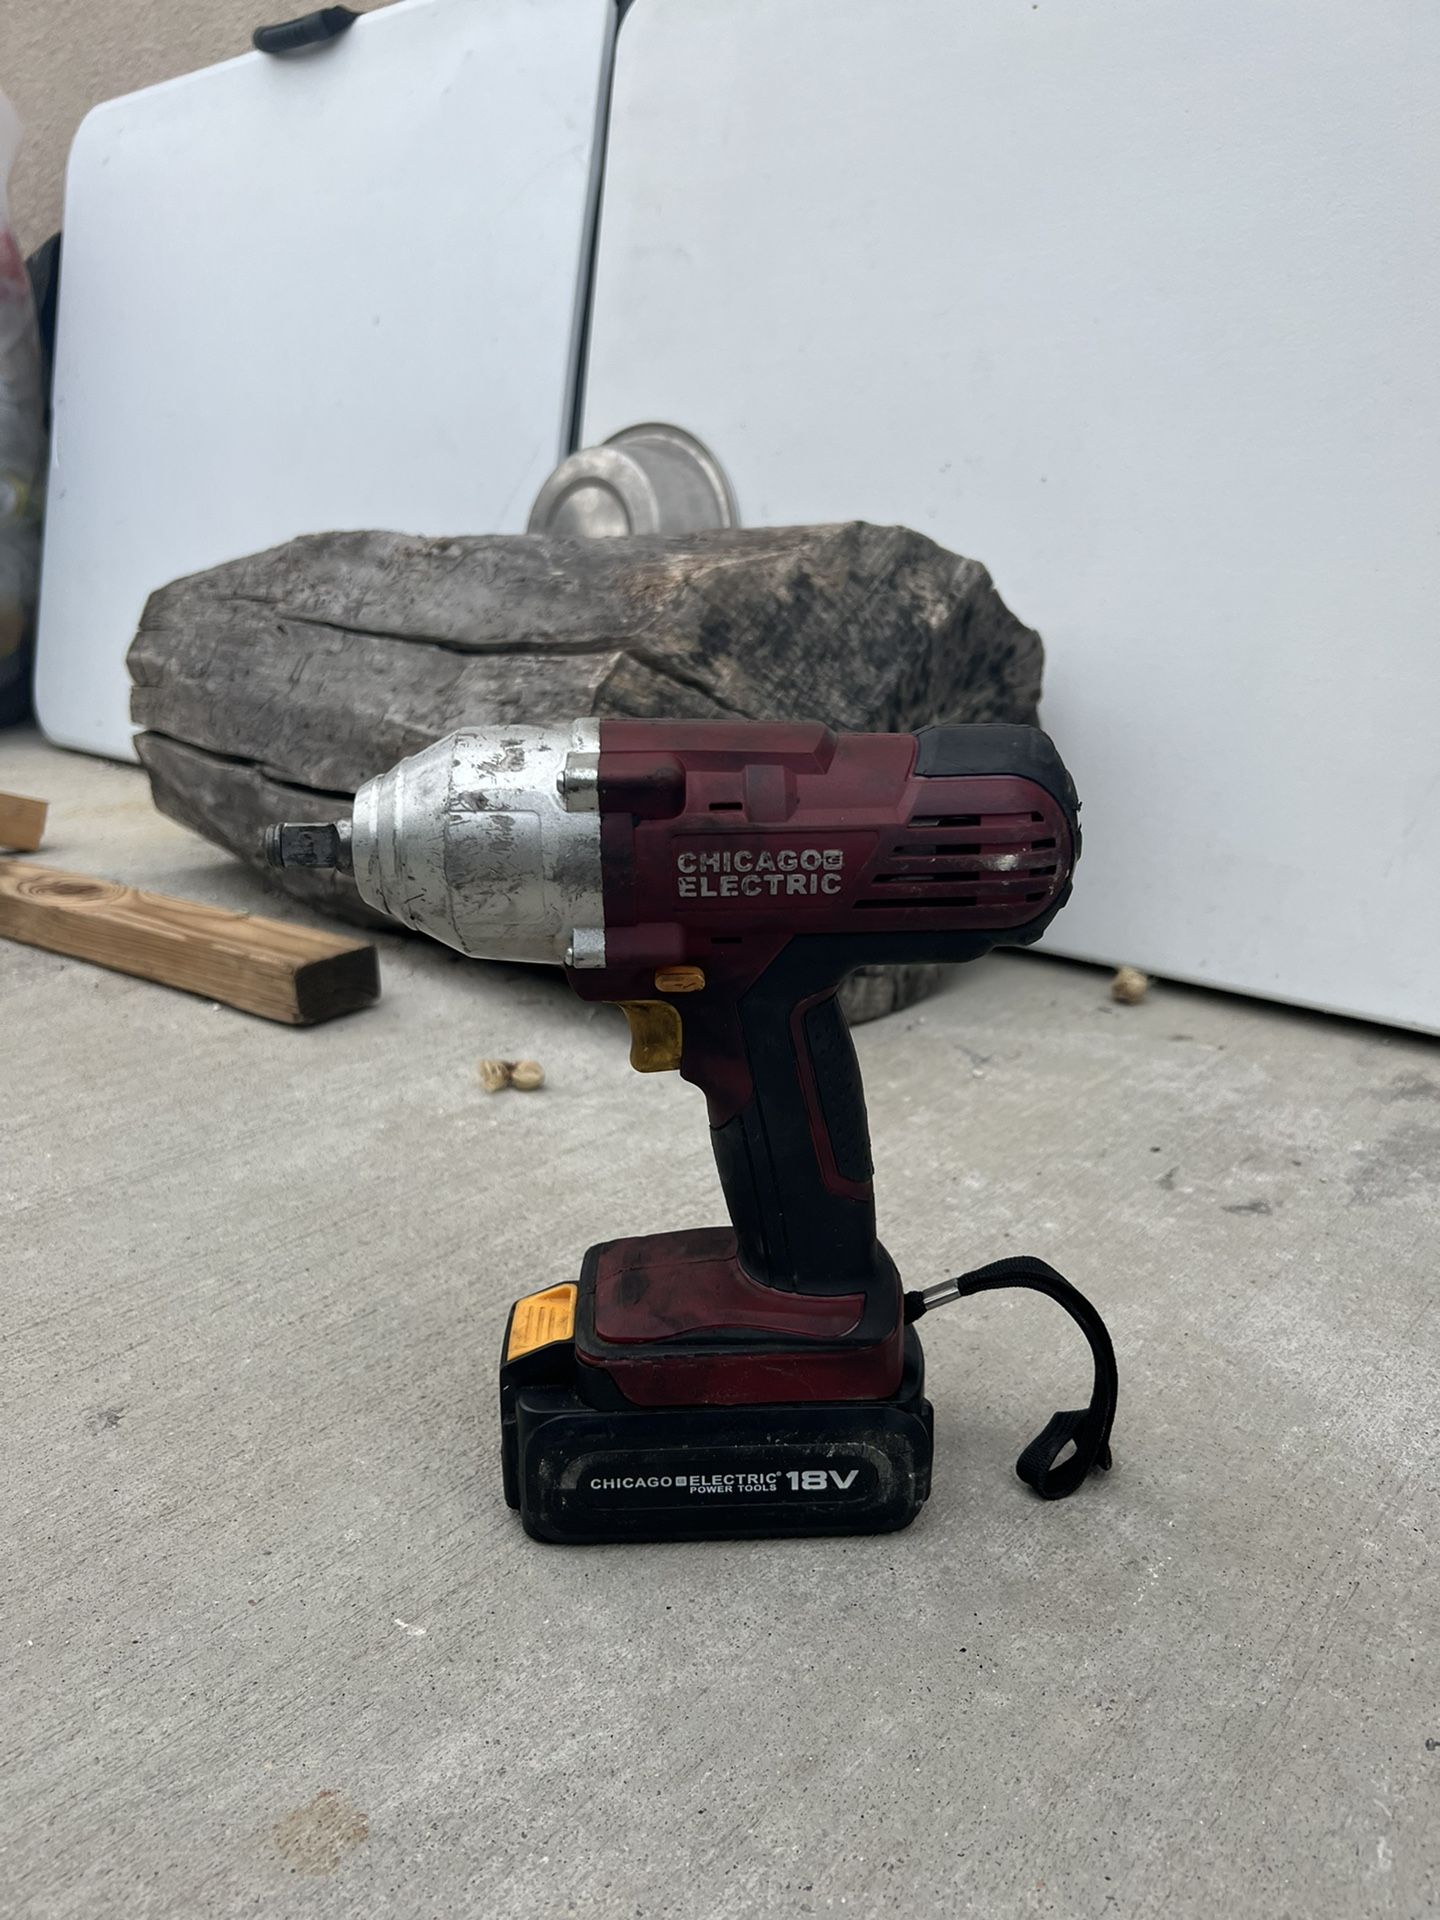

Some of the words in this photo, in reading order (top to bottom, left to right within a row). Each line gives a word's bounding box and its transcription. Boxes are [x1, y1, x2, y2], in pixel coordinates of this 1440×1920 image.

[678, 849, 821, 873] CHICAGO
[678, 873, 842, 897] ELECTRIC
[590, 1476, 672, 1490] CHICAGO
[785, 1470, 859, 1491] 18V
[690, 1485, 733, 1494] POWER
[737, 1484, 777, 1493] TOOLS
